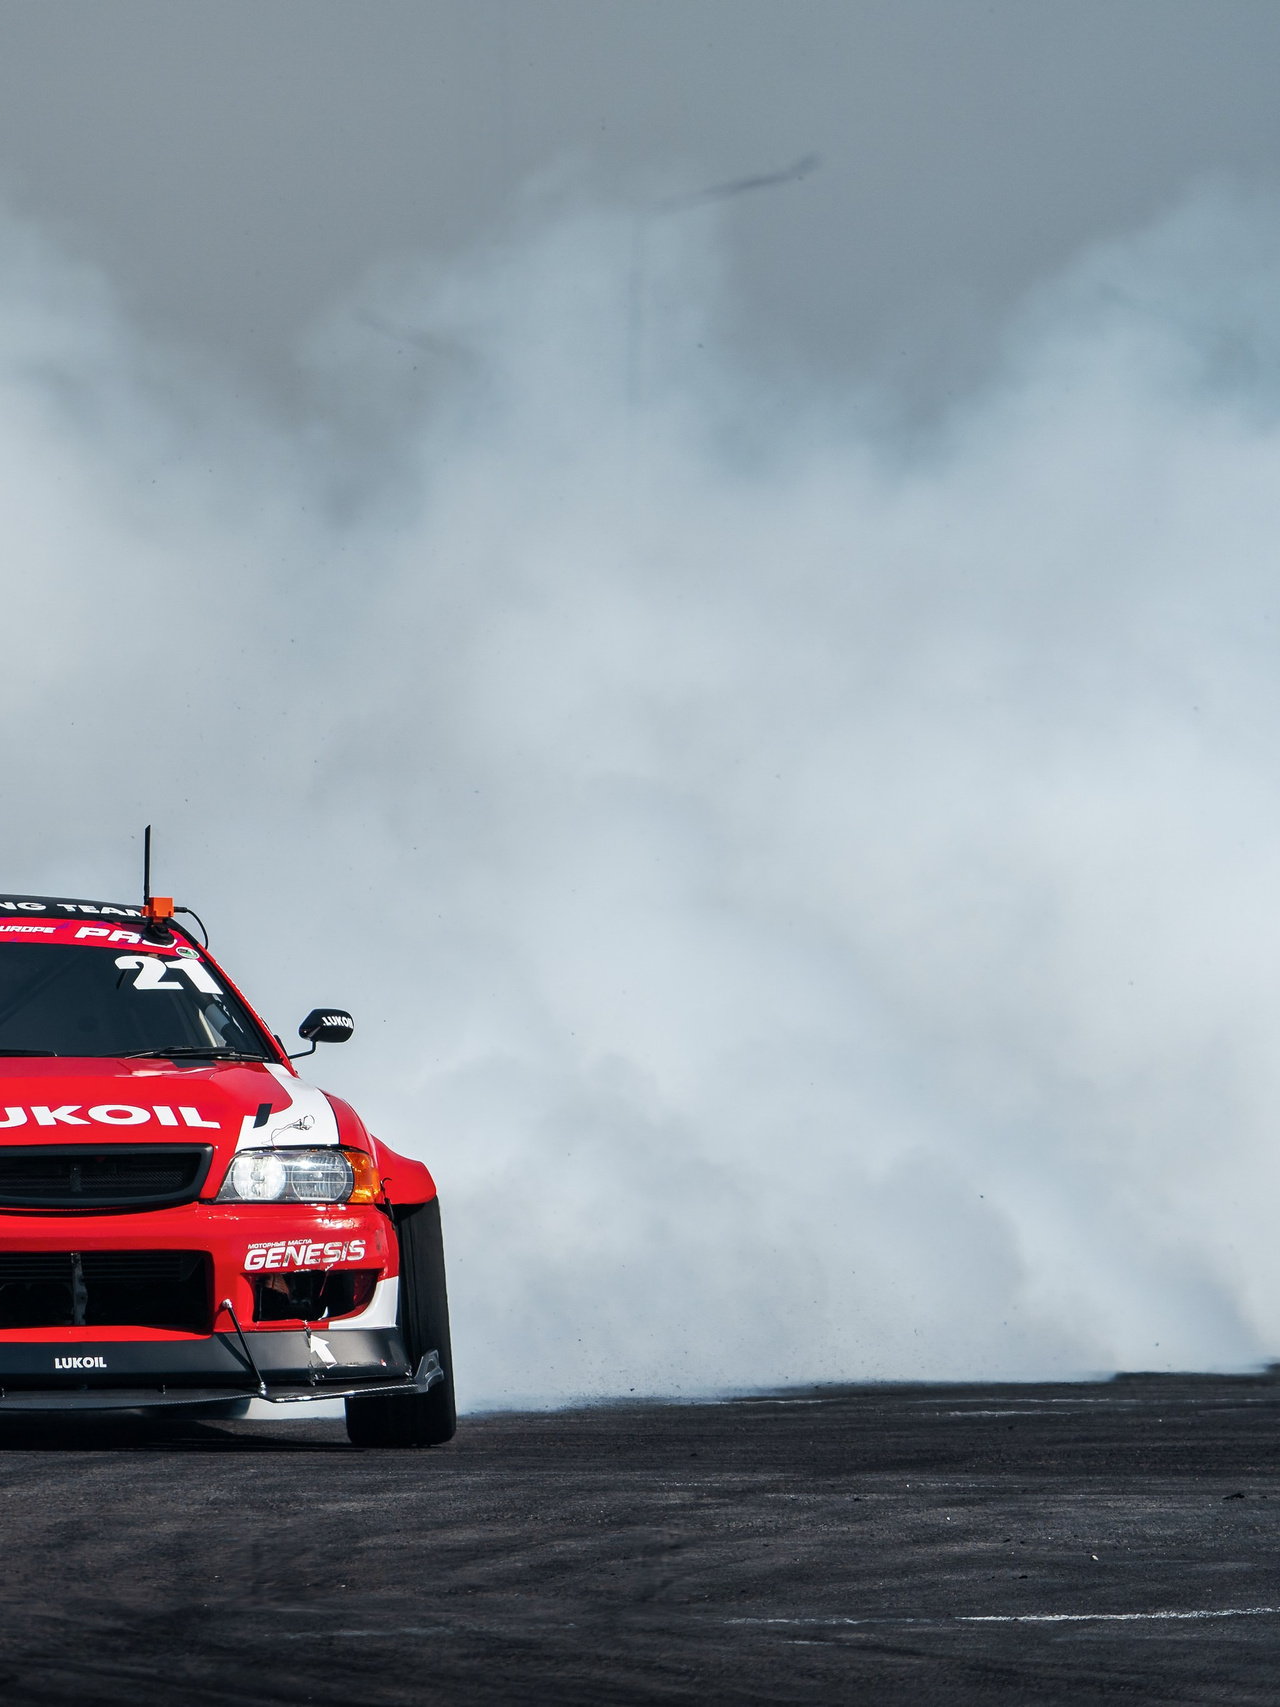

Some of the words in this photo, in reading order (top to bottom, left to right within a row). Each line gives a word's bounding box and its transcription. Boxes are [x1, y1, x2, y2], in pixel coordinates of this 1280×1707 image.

[114, 955, 223, 994] 21
[244, 1239, 365, 1271] GENESIS
[248, 1241, 286, 1249] МОТОРНЫЕ
[54, 1356, 107, 1369] LUKOIL
